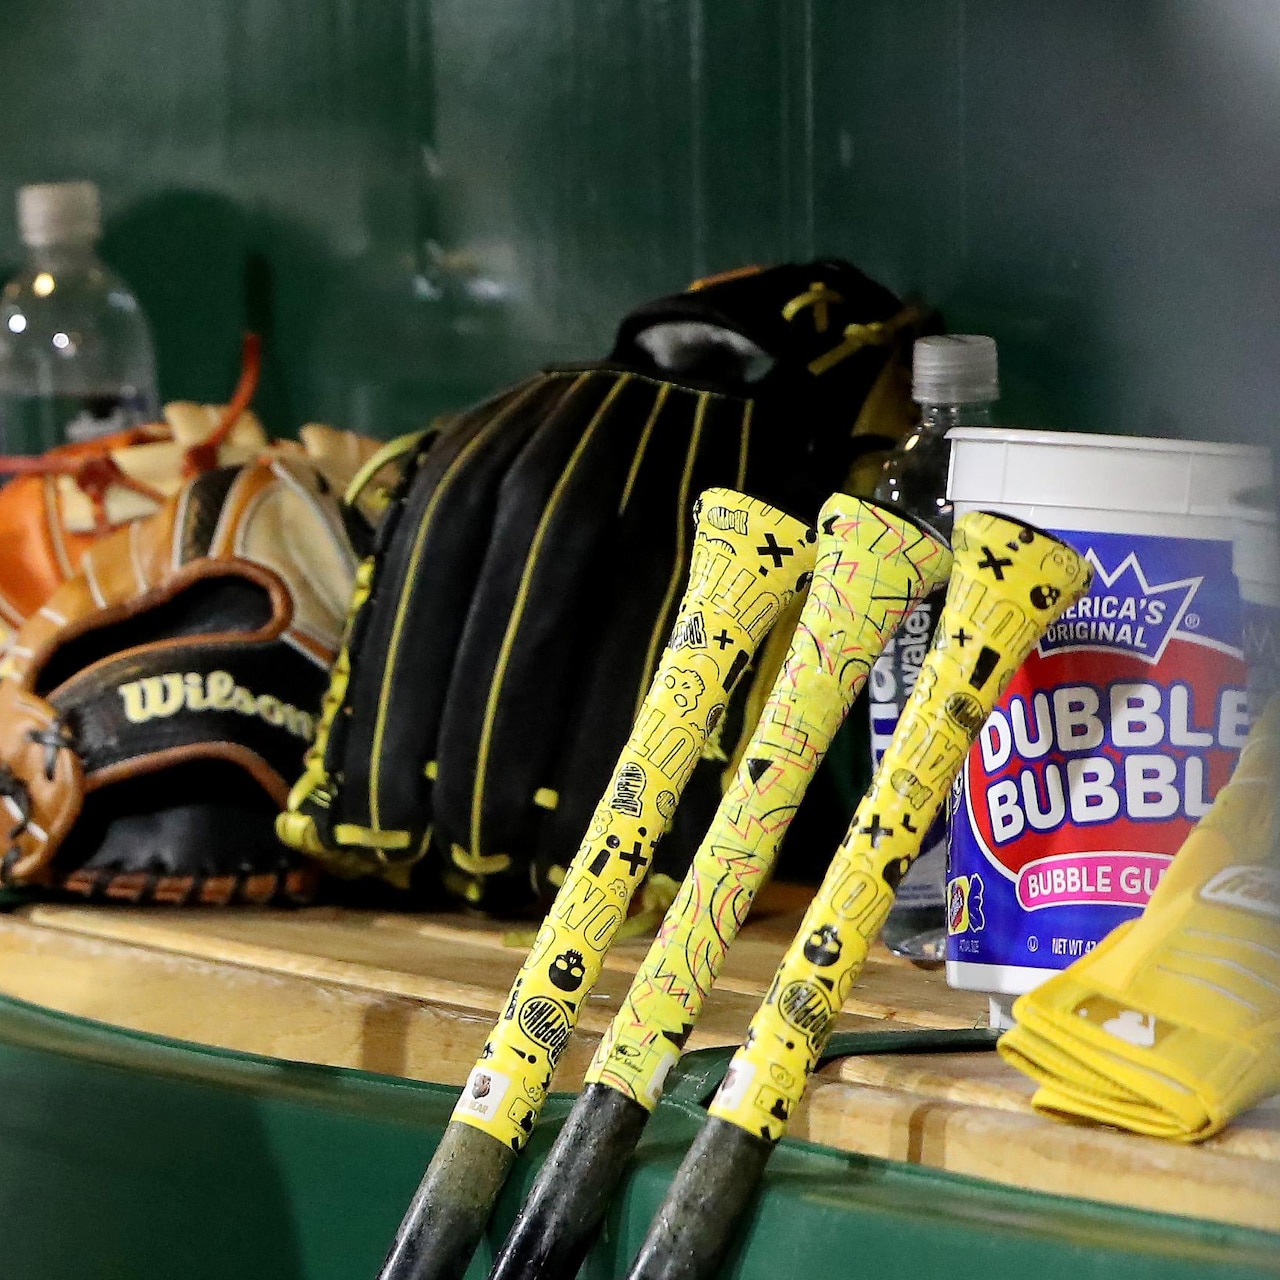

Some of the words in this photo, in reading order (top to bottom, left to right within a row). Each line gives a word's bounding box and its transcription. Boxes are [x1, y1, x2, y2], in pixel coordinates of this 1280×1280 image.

[1060, 595, 1166, 625] ERICA'S
[1046, 621, 1147, 649] ORIGINAL
[119, 670, 315, 741] Wilson
[981, 682, 1252, 773] DUBBLE
[986, 753, 1216, 846] BUBBL
[1027, 866, 1113, 899] BUBBLE
[1119, 866, 1168, 896] GU
[1052, 938, 1068, 955] NET
[1068, 940, 1084, 957] WT
